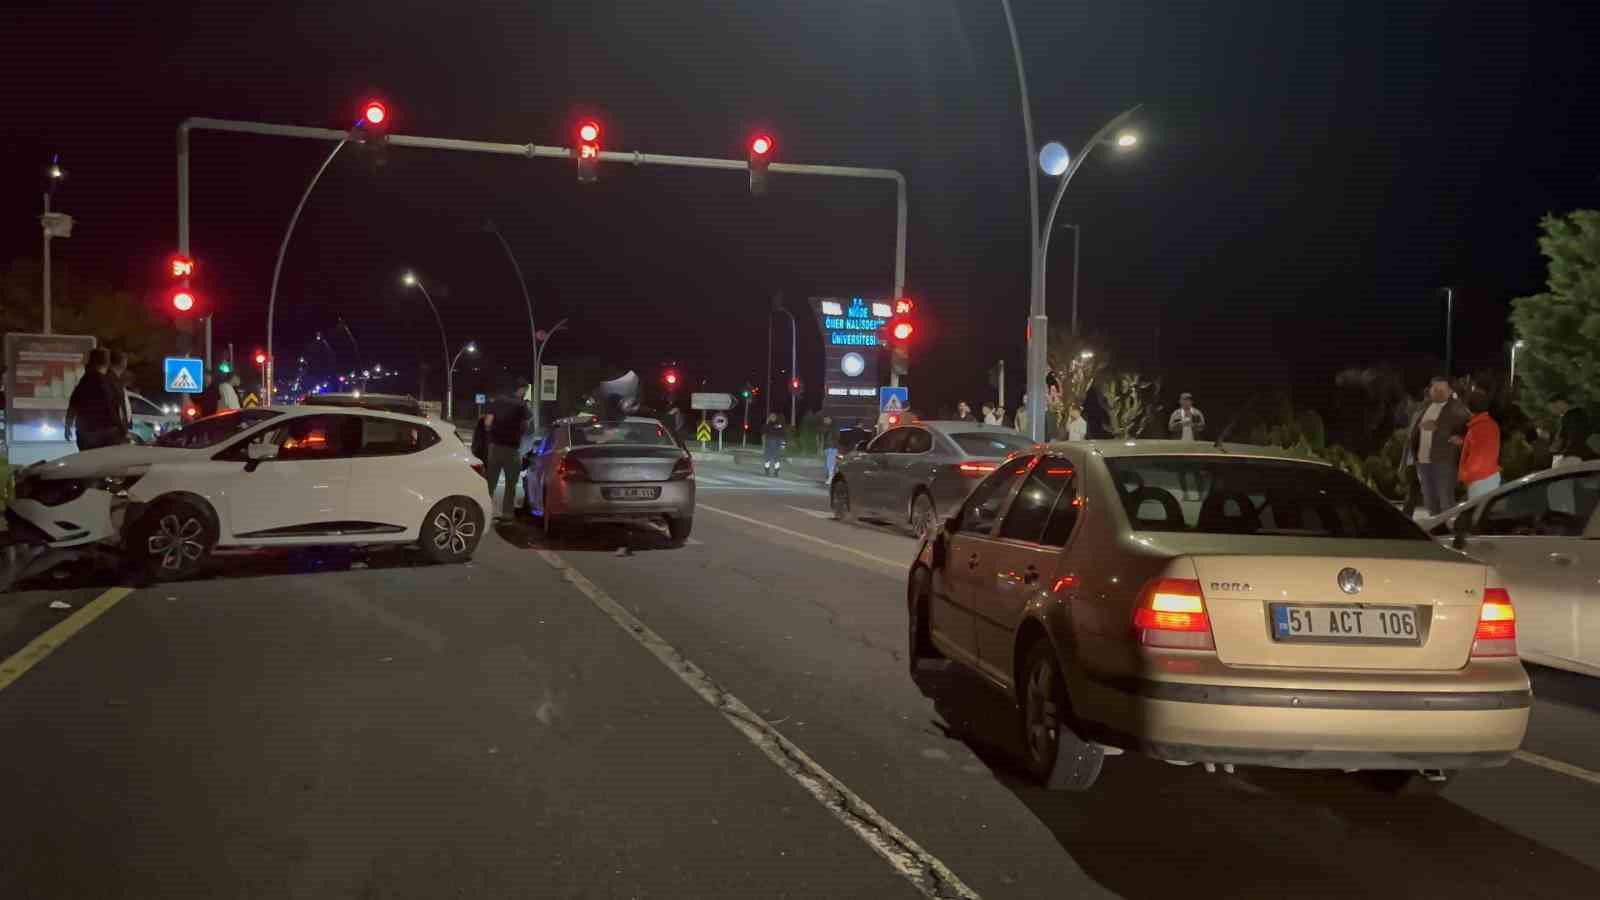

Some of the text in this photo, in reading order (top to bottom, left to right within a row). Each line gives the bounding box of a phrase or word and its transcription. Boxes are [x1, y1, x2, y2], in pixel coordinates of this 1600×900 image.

[1210, 582, 1251, 592] BORA
[1289, 609, 1414, 635] 51 ACT 106
